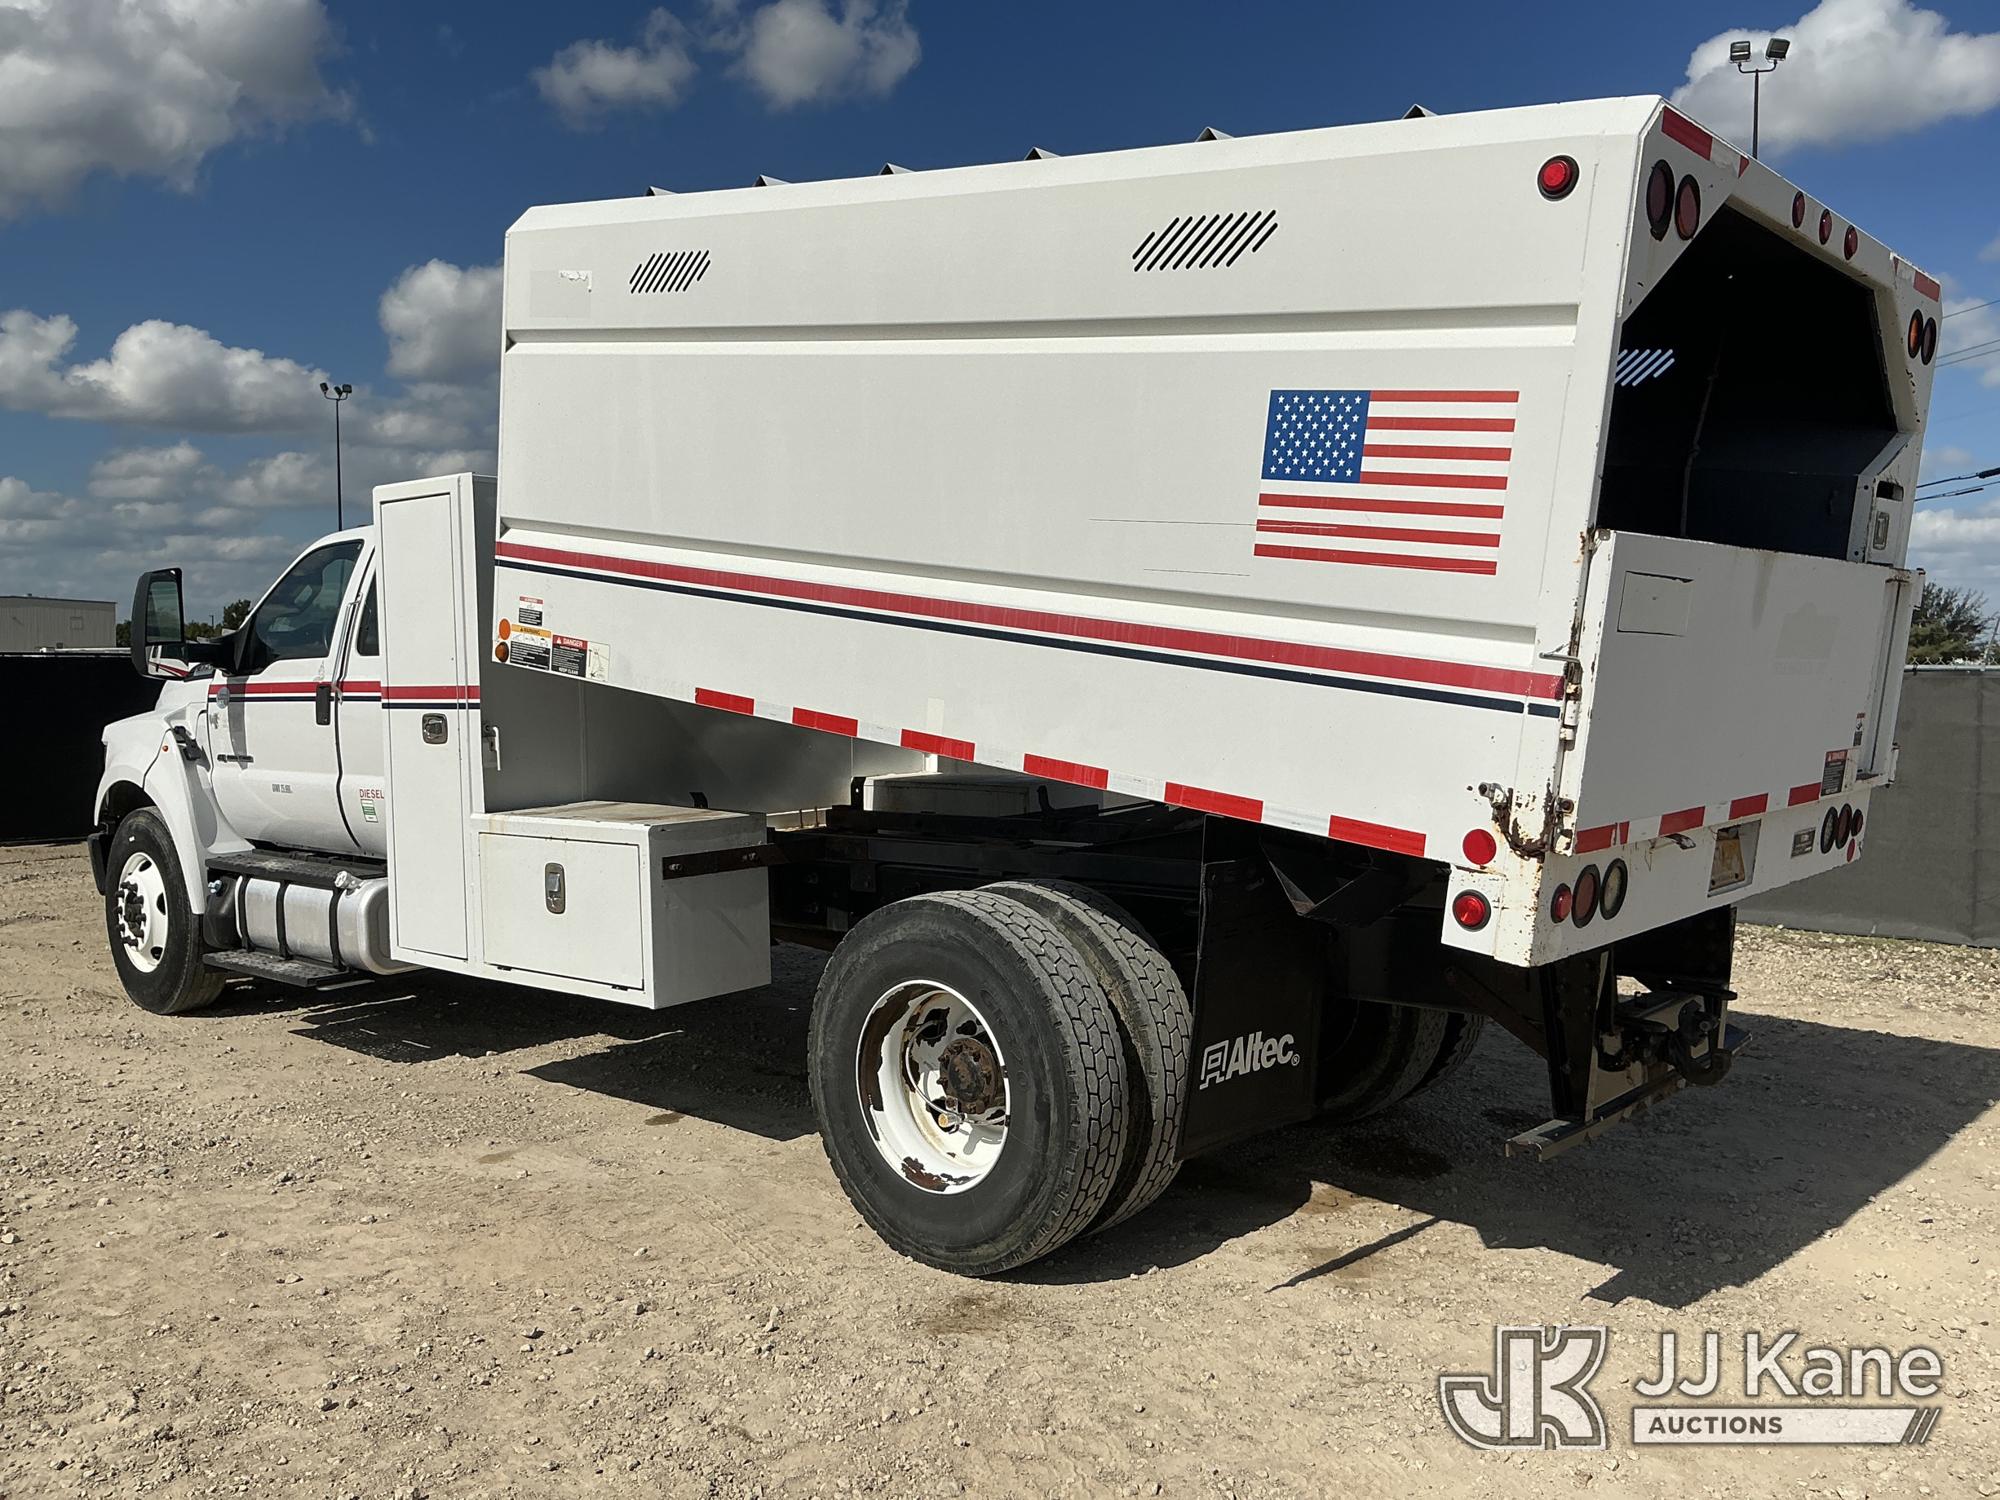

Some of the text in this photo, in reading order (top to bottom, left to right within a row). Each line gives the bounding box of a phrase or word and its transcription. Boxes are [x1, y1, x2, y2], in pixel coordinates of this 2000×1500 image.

[562, 637, 583, 648] DANGER
[360, 789, 384, 799] DIESEL
[1225, 1031, 1294, 1080] Altec
